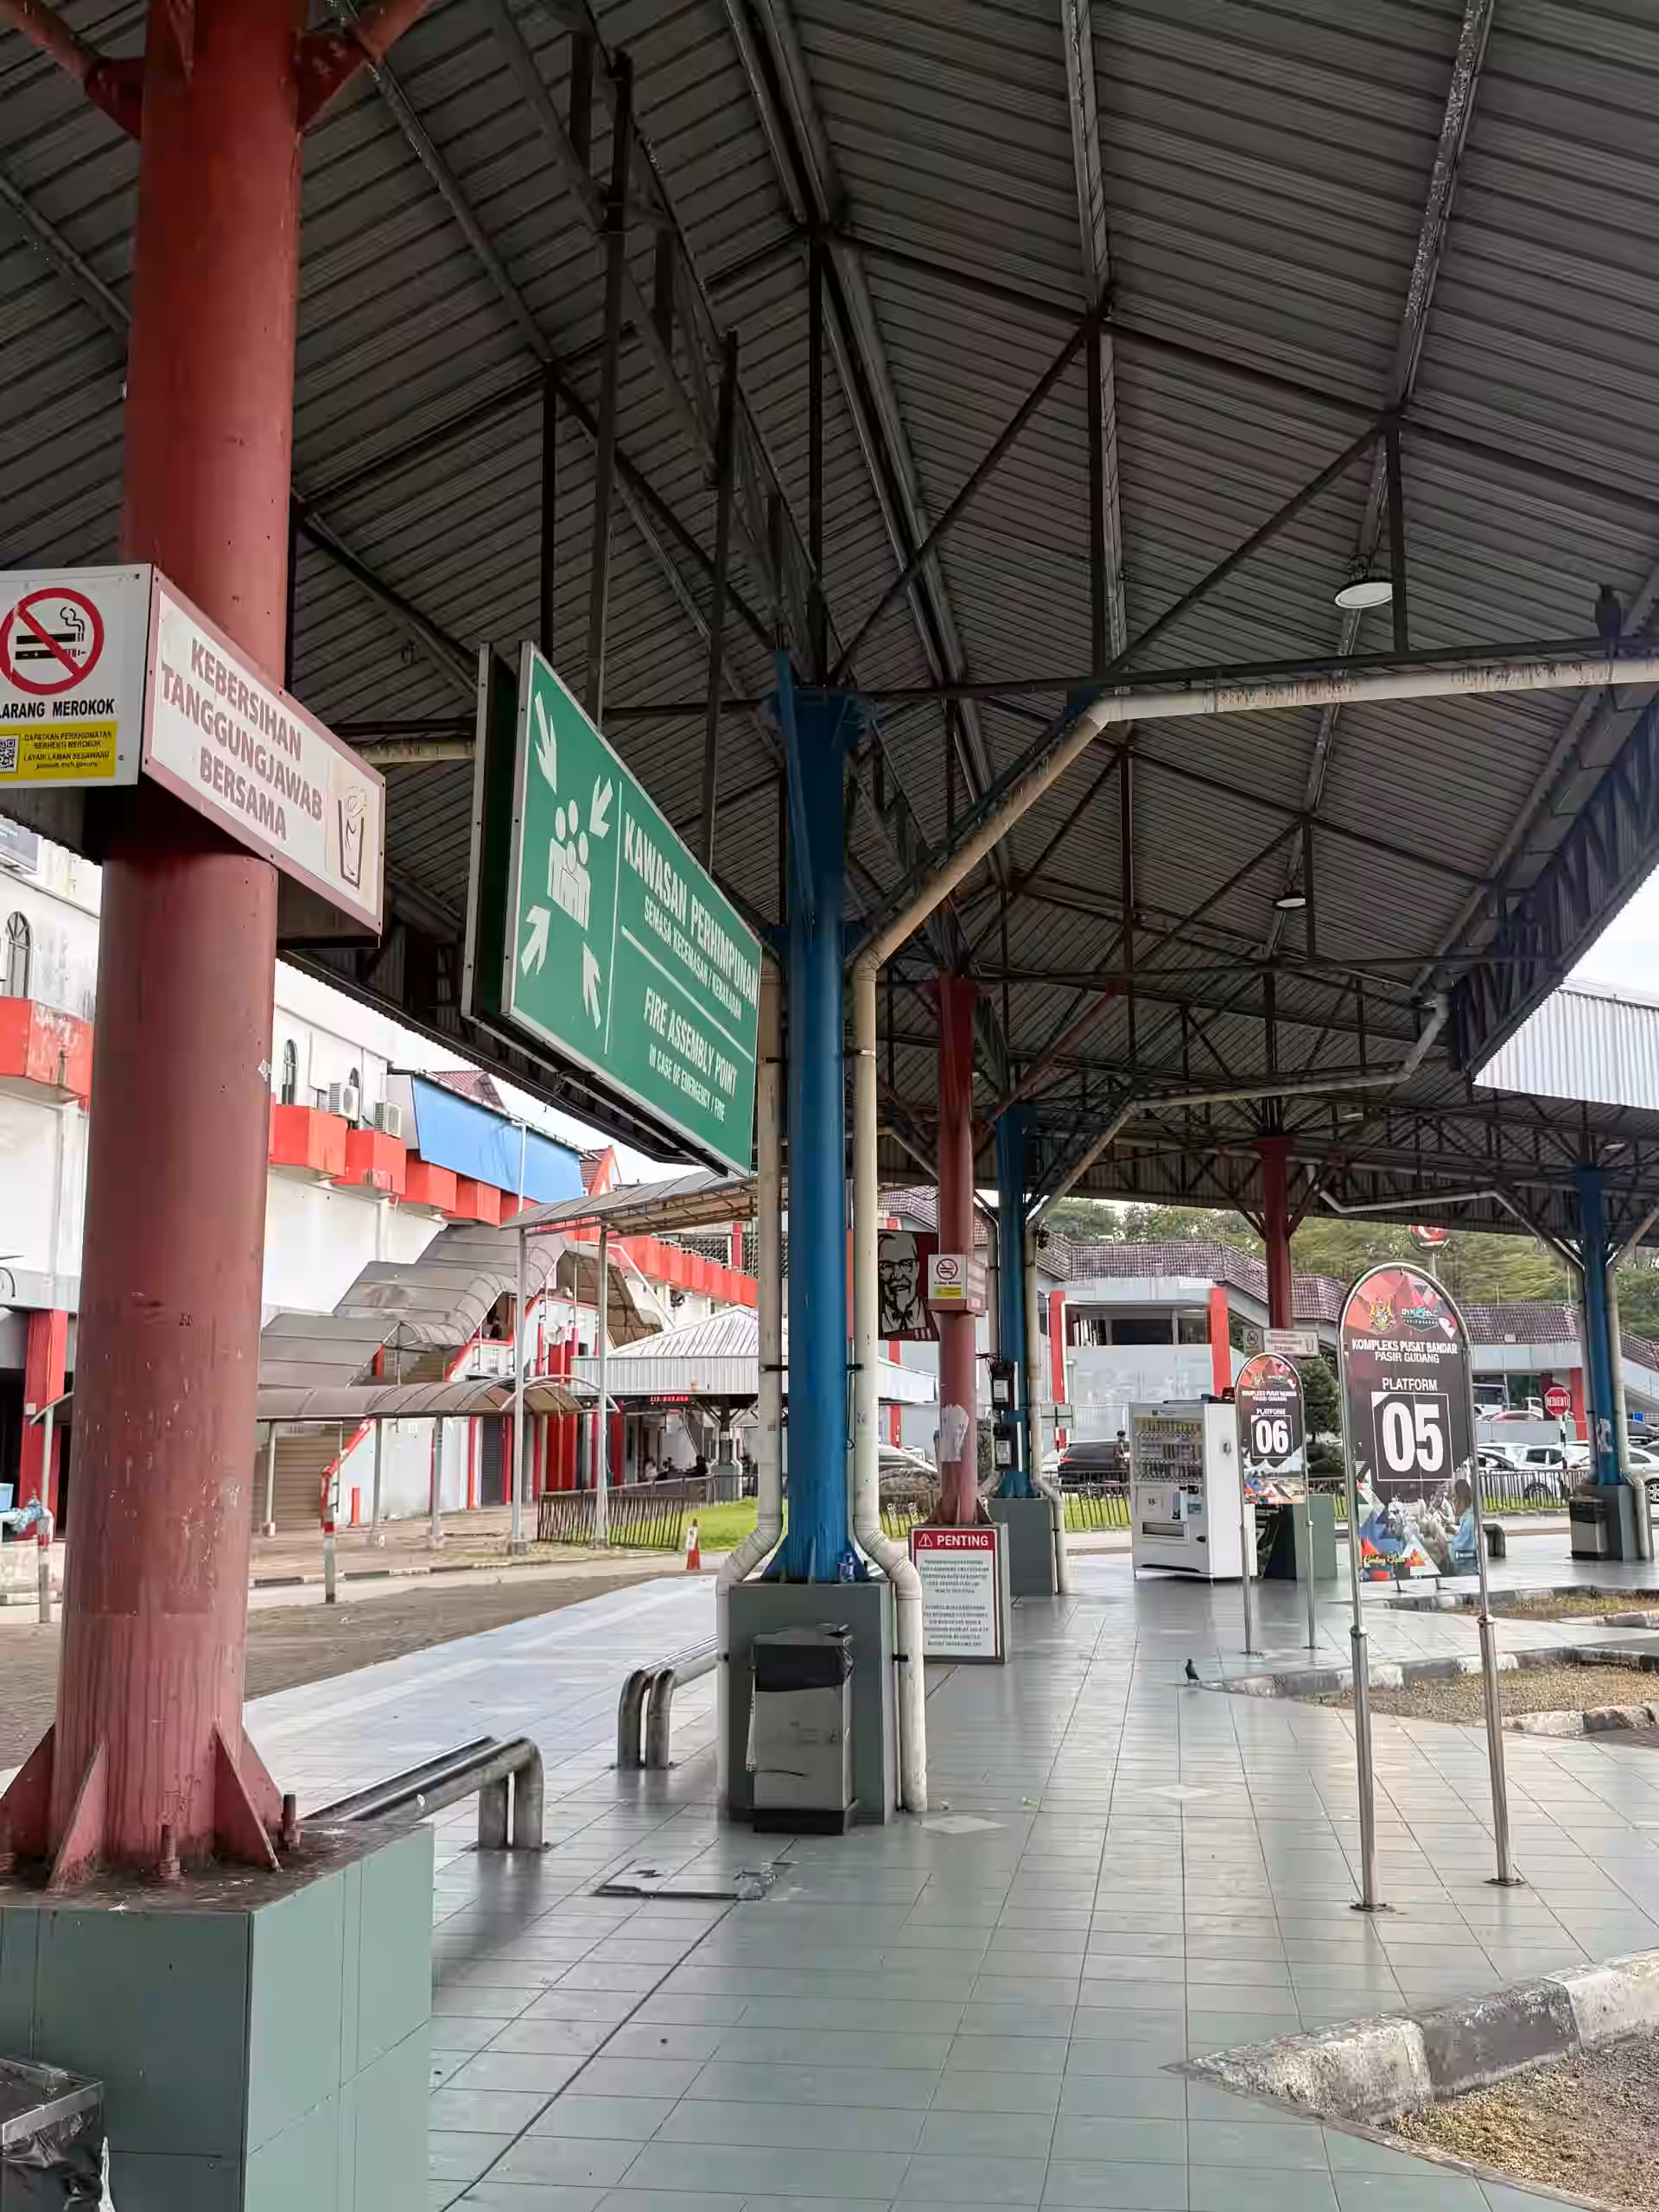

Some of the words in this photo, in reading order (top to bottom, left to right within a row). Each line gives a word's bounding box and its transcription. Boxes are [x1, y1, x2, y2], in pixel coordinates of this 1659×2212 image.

[0, 702, 45, 719] ARANG
[52, 698, 115, 716] MEROKOK
[191, 637, 302, 761] KEBERSIHAN
[161, 664, 323, 821] TANGGUNGJAWAB
[200, 746, 287, 841] BERSAMA
[624, 811, 688, 927] KAWASAN
[690, 893, 759, 1010] PERHIMPUNAN
[644, 895, 671, 947] SEMASA
[672, 925, 708, 988] KECEMASAN
[644, 986, 669, 1038] FIRE
[667, 1009, 715, 1078] ASSEMBLY
[714, 1052, 738, 1099] POINT
[649, 1043, 657, 1068] IN
[657, 1050, 673, 1080] CASE
[672, 1063, 681, 1086] OF
[681, 1070, 711, 1109] EMERGENCY
[714, 1096, 727, 1123] FIRE
[1351, 1338, 1399, 1351] KOMPLEKS
[1400, 1340, 1425, 1353] PUSAT
[1426, 1342, 1458, 1355] BANDAR
[1375, 1351, 1402, 1362] PASIR
[1403, 1352, 1440, 1363] GUDANG
[1382, 1376, 1438, 1391] PLATFORM
[1255, 1419, 1289, 1454] 06
[1382, 1401, 1444, 1472] 05
[937, 1535, 988, 1547] PENTING
